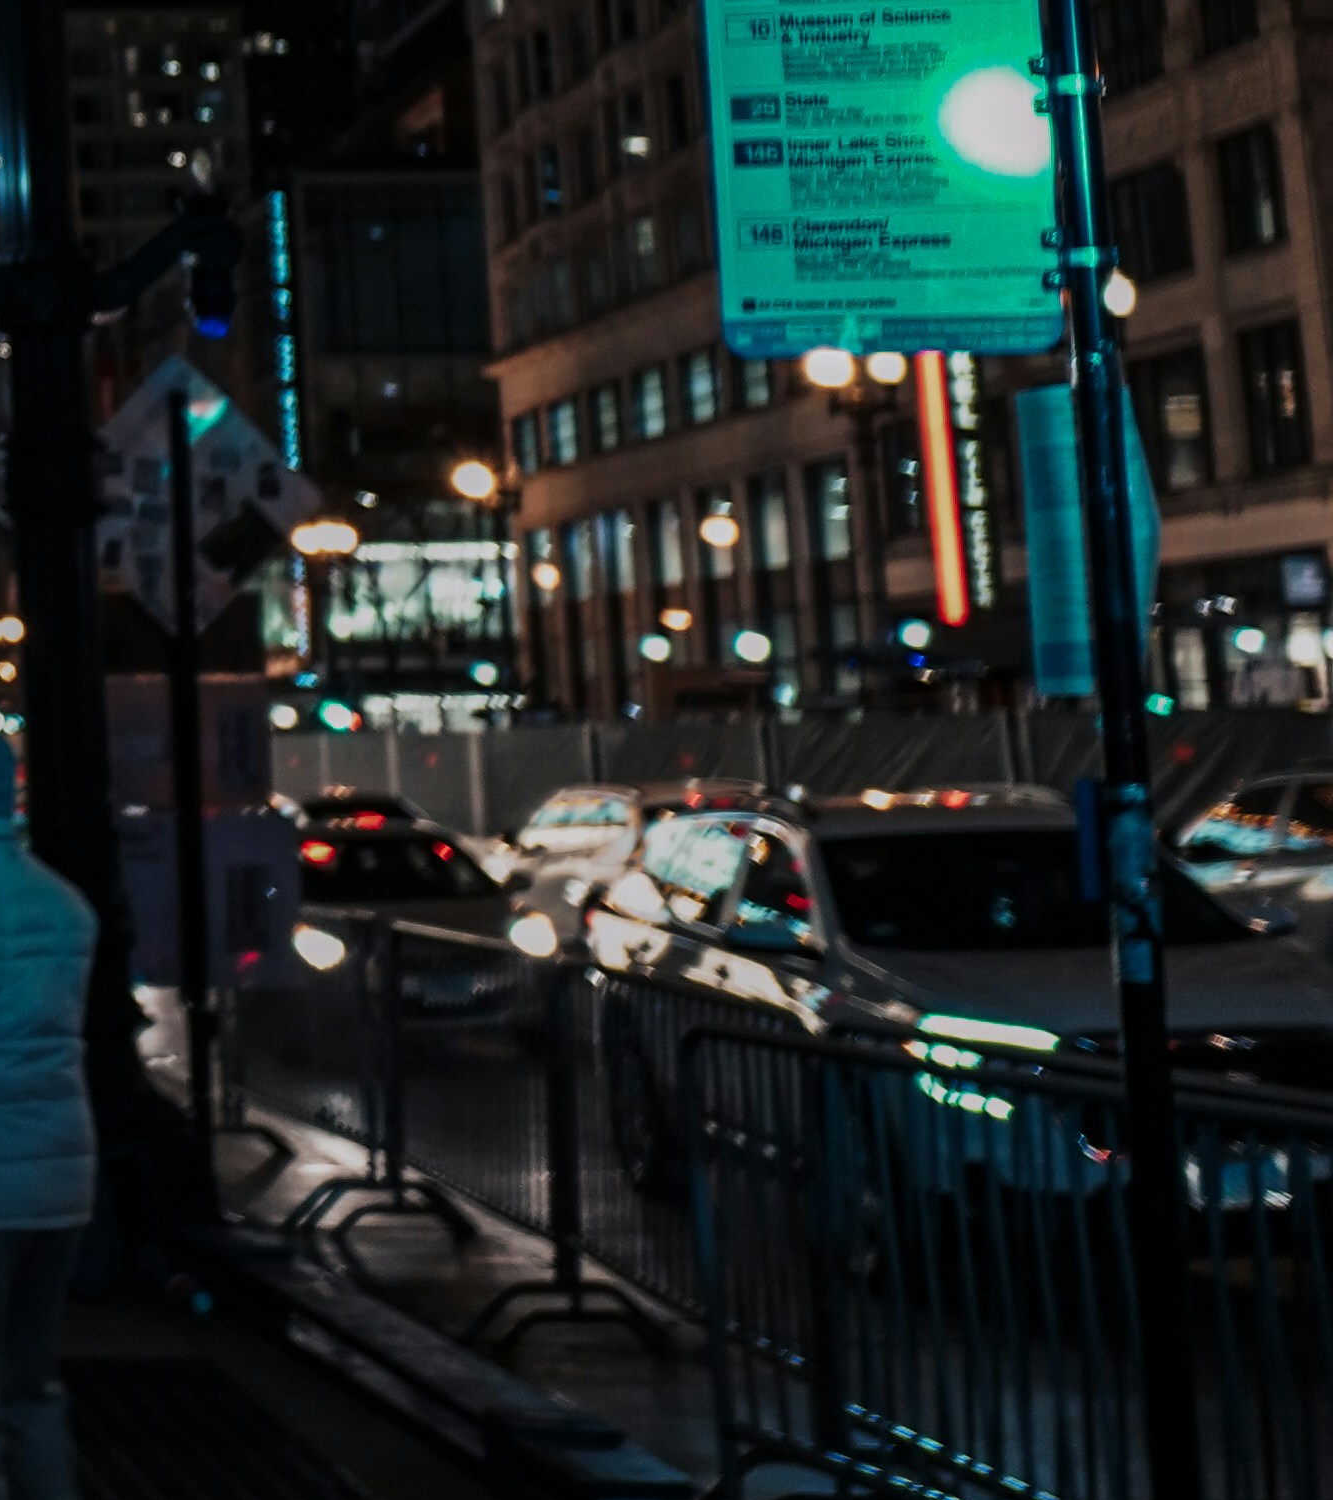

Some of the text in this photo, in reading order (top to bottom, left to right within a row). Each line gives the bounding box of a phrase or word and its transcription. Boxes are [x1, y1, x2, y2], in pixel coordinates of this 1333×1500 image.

[779, 11, 854, 30] Museum
[860, 8, 877, 26] of
[882, 6, 952, 26] Science
[799, 27, 871, 50] Industry
[794, 232, 953, 256] Michigan Express
